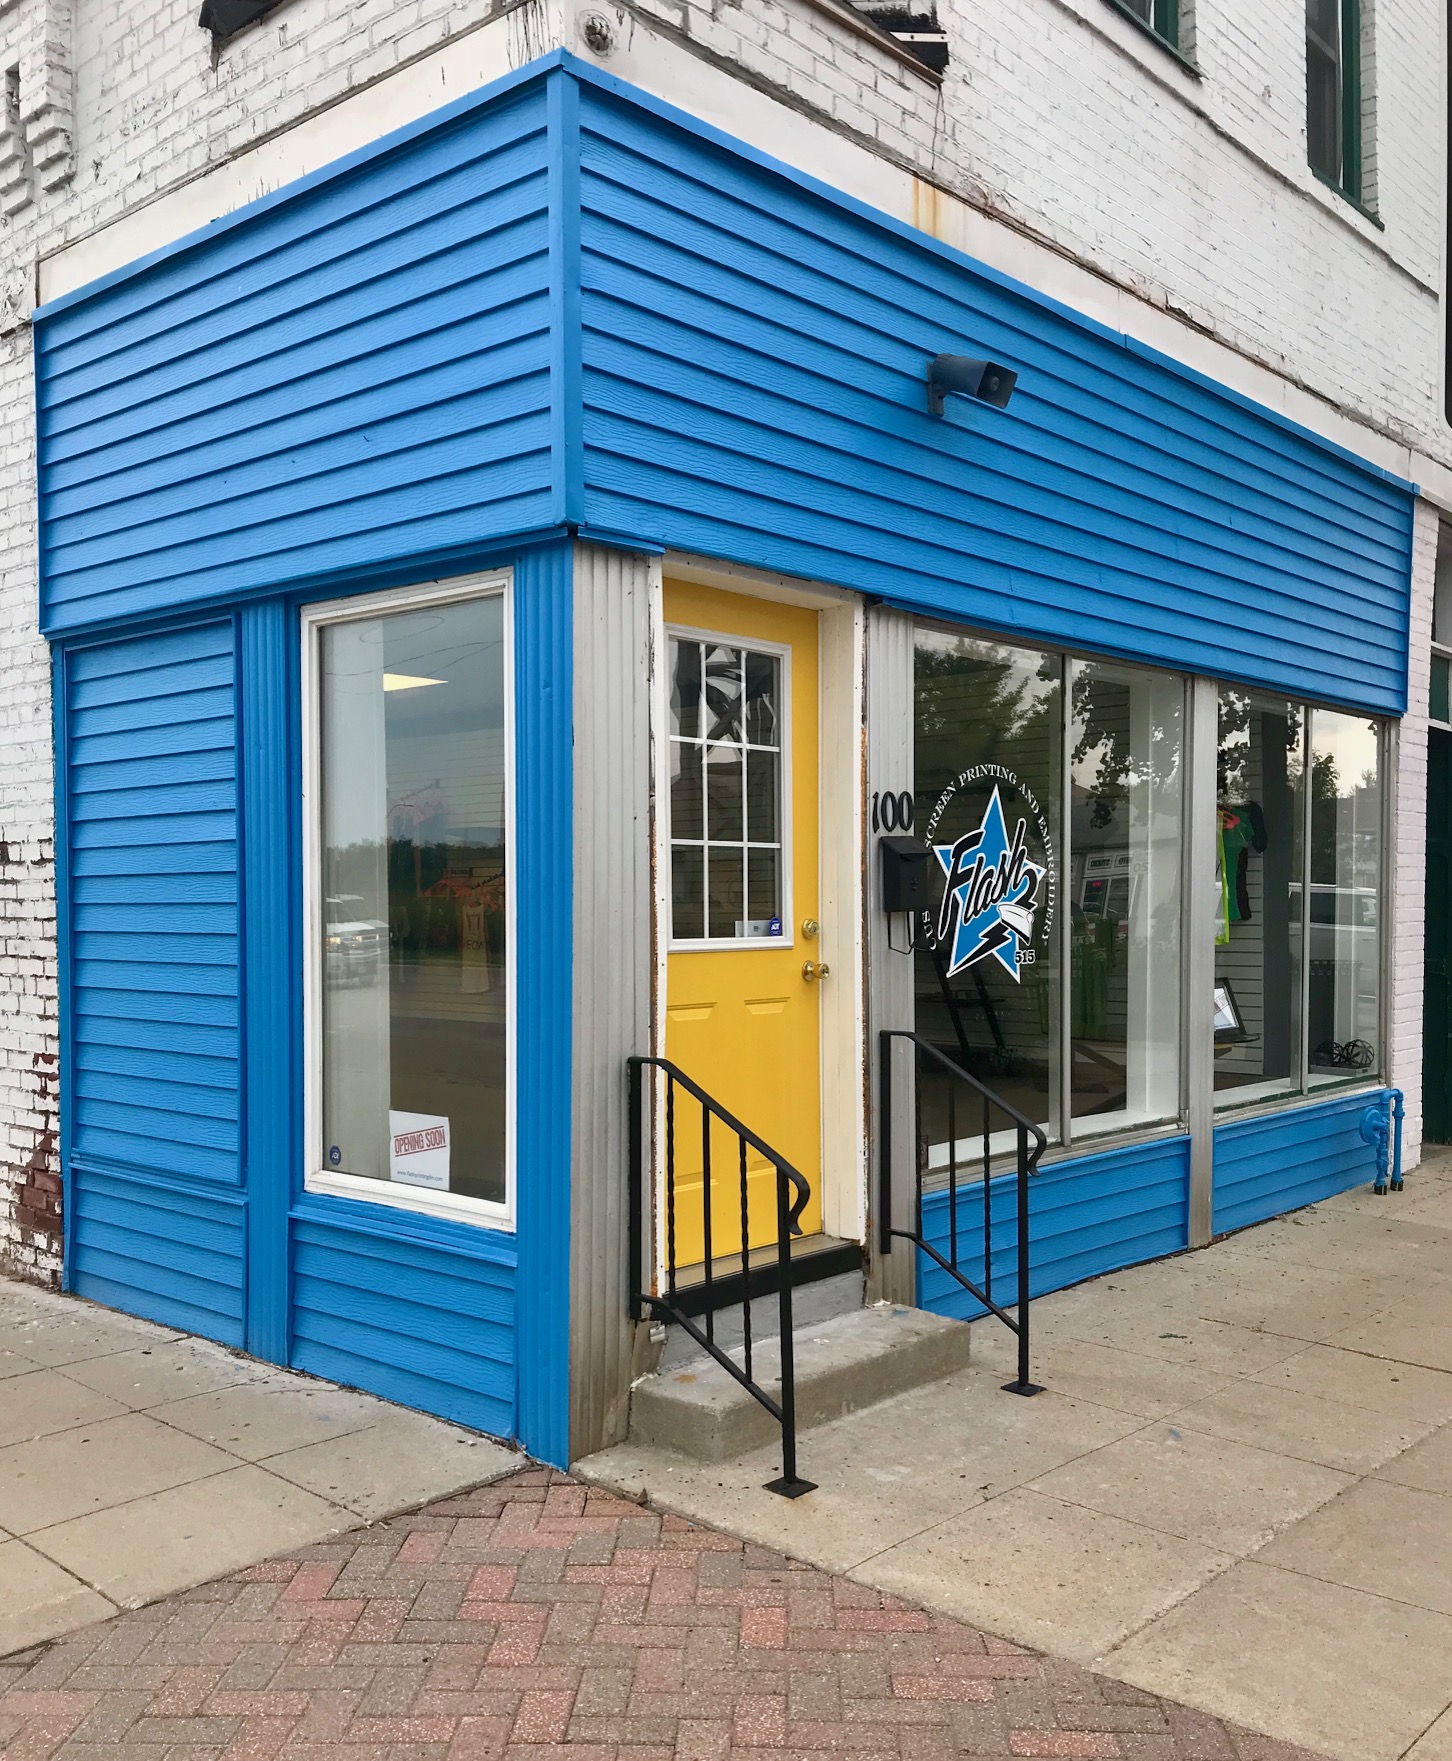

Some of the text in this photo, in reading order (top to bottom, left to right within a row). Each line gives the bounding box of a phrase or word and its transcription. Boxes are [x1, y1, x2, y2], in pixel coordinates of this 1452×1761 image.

[959, 764, 1017, 788] PRINTING
[872, 791, 914, 833] 100
[924, 781, 957, 848] SCREEN
[1018, 783, 1040, 814] AND
[937, 817, 1038, 941] Flash
[922, 911, 937, 950] CUS
[1014, 949, 1036, 965] 515
[395, 1129, 446, 1154] OPENING SOON
